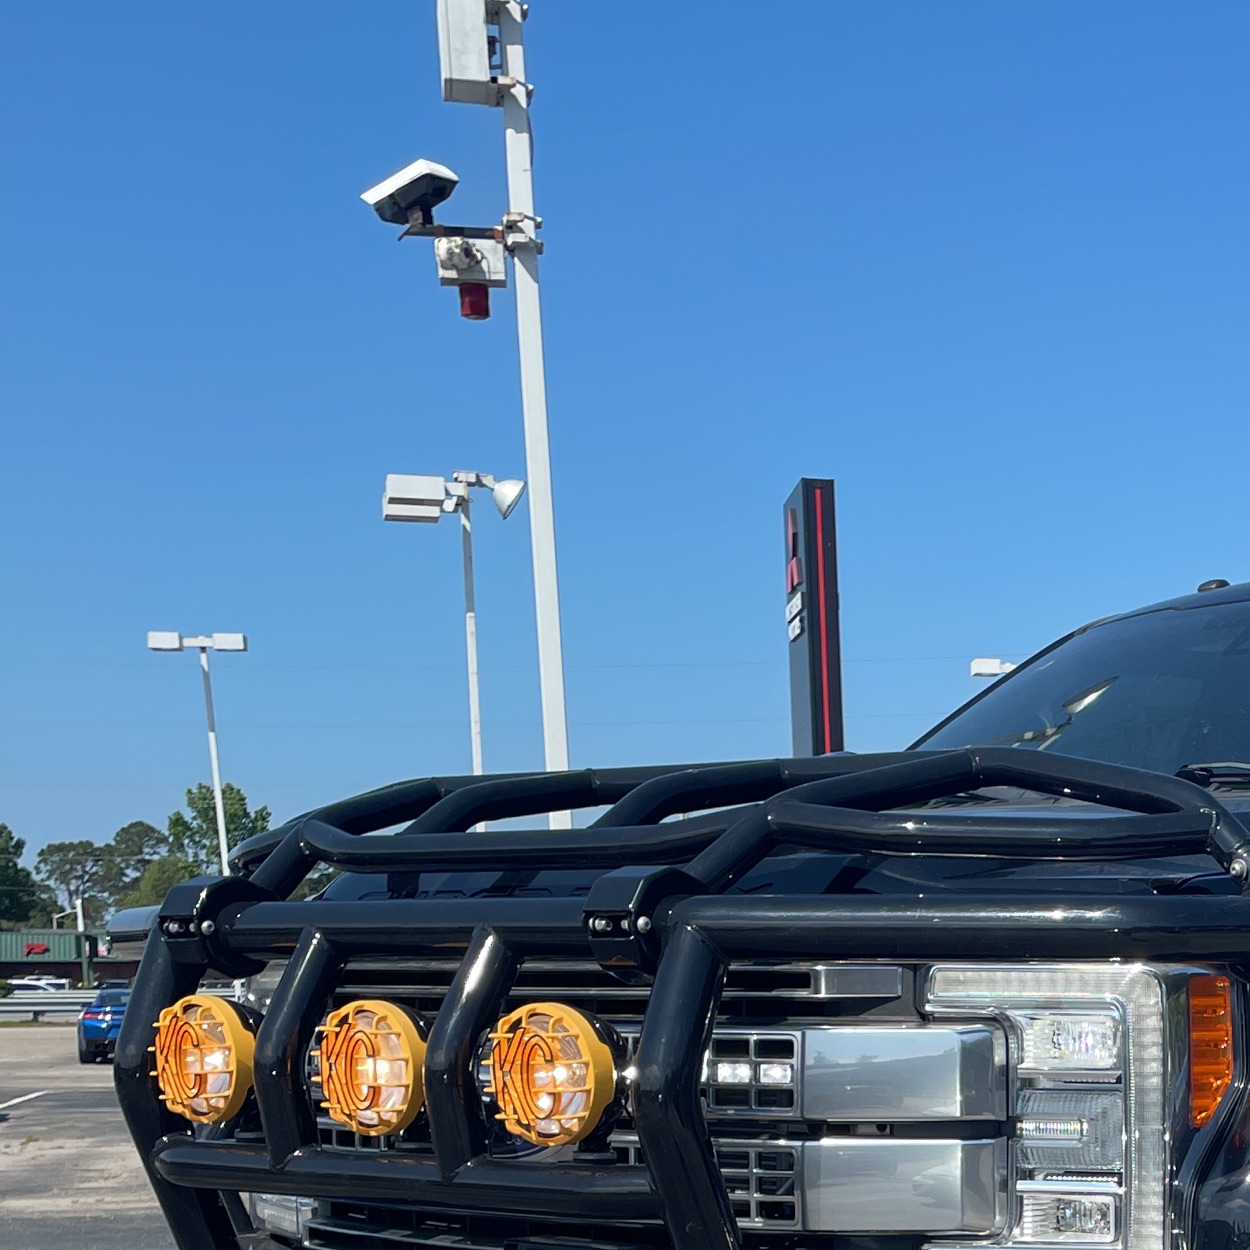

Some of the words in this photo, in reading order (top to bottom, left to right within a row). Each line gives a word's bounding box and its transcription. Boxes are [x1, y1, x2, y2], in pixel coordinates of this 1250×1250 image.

[156, 1014, 201, 1104] KC
[320, 1022, 376, 1116] KC
[492, 1027, 557, 1126] KC
